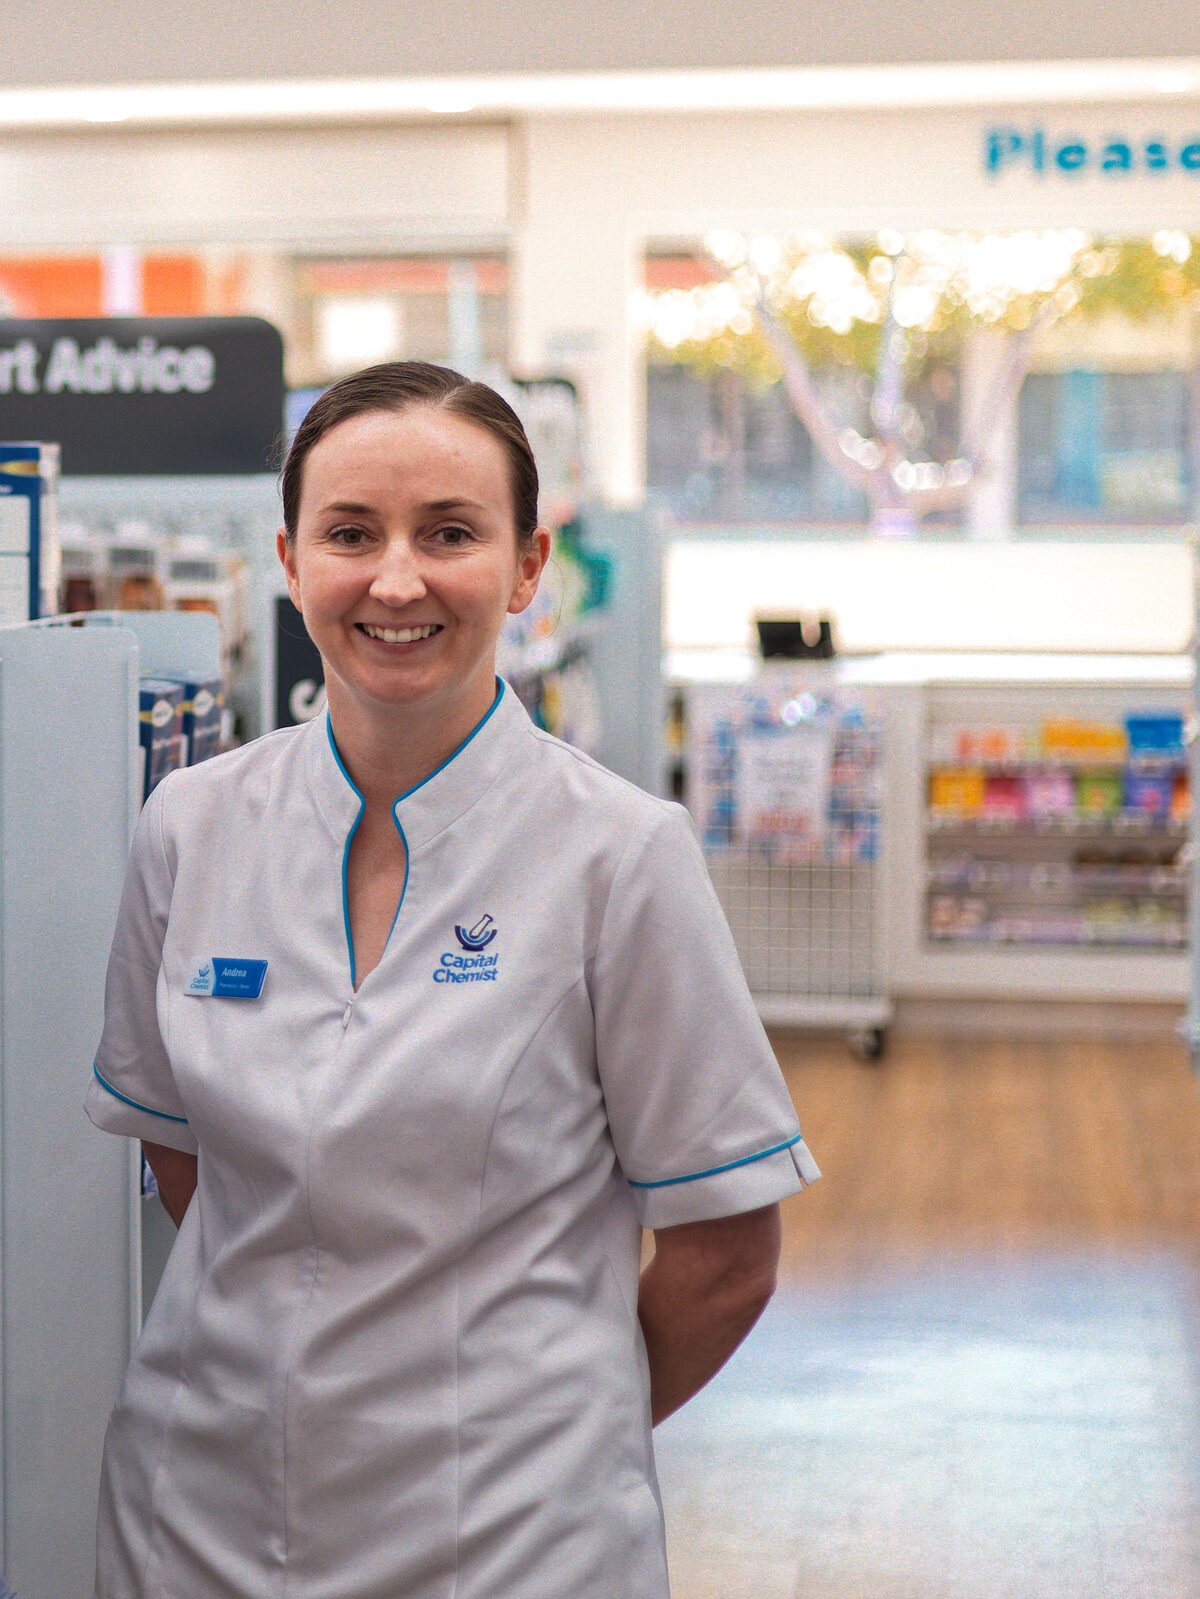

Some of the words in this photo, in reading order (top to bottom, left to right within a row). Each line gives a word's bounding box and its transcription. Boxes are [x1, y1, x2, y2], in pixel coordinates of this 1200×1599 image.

[44, 336, 217, 395] Advice
[440, 952, 499, 971] Capital
[221, 967, 247, 978] Andrea
[433, 968, 499, 983] Chemist
